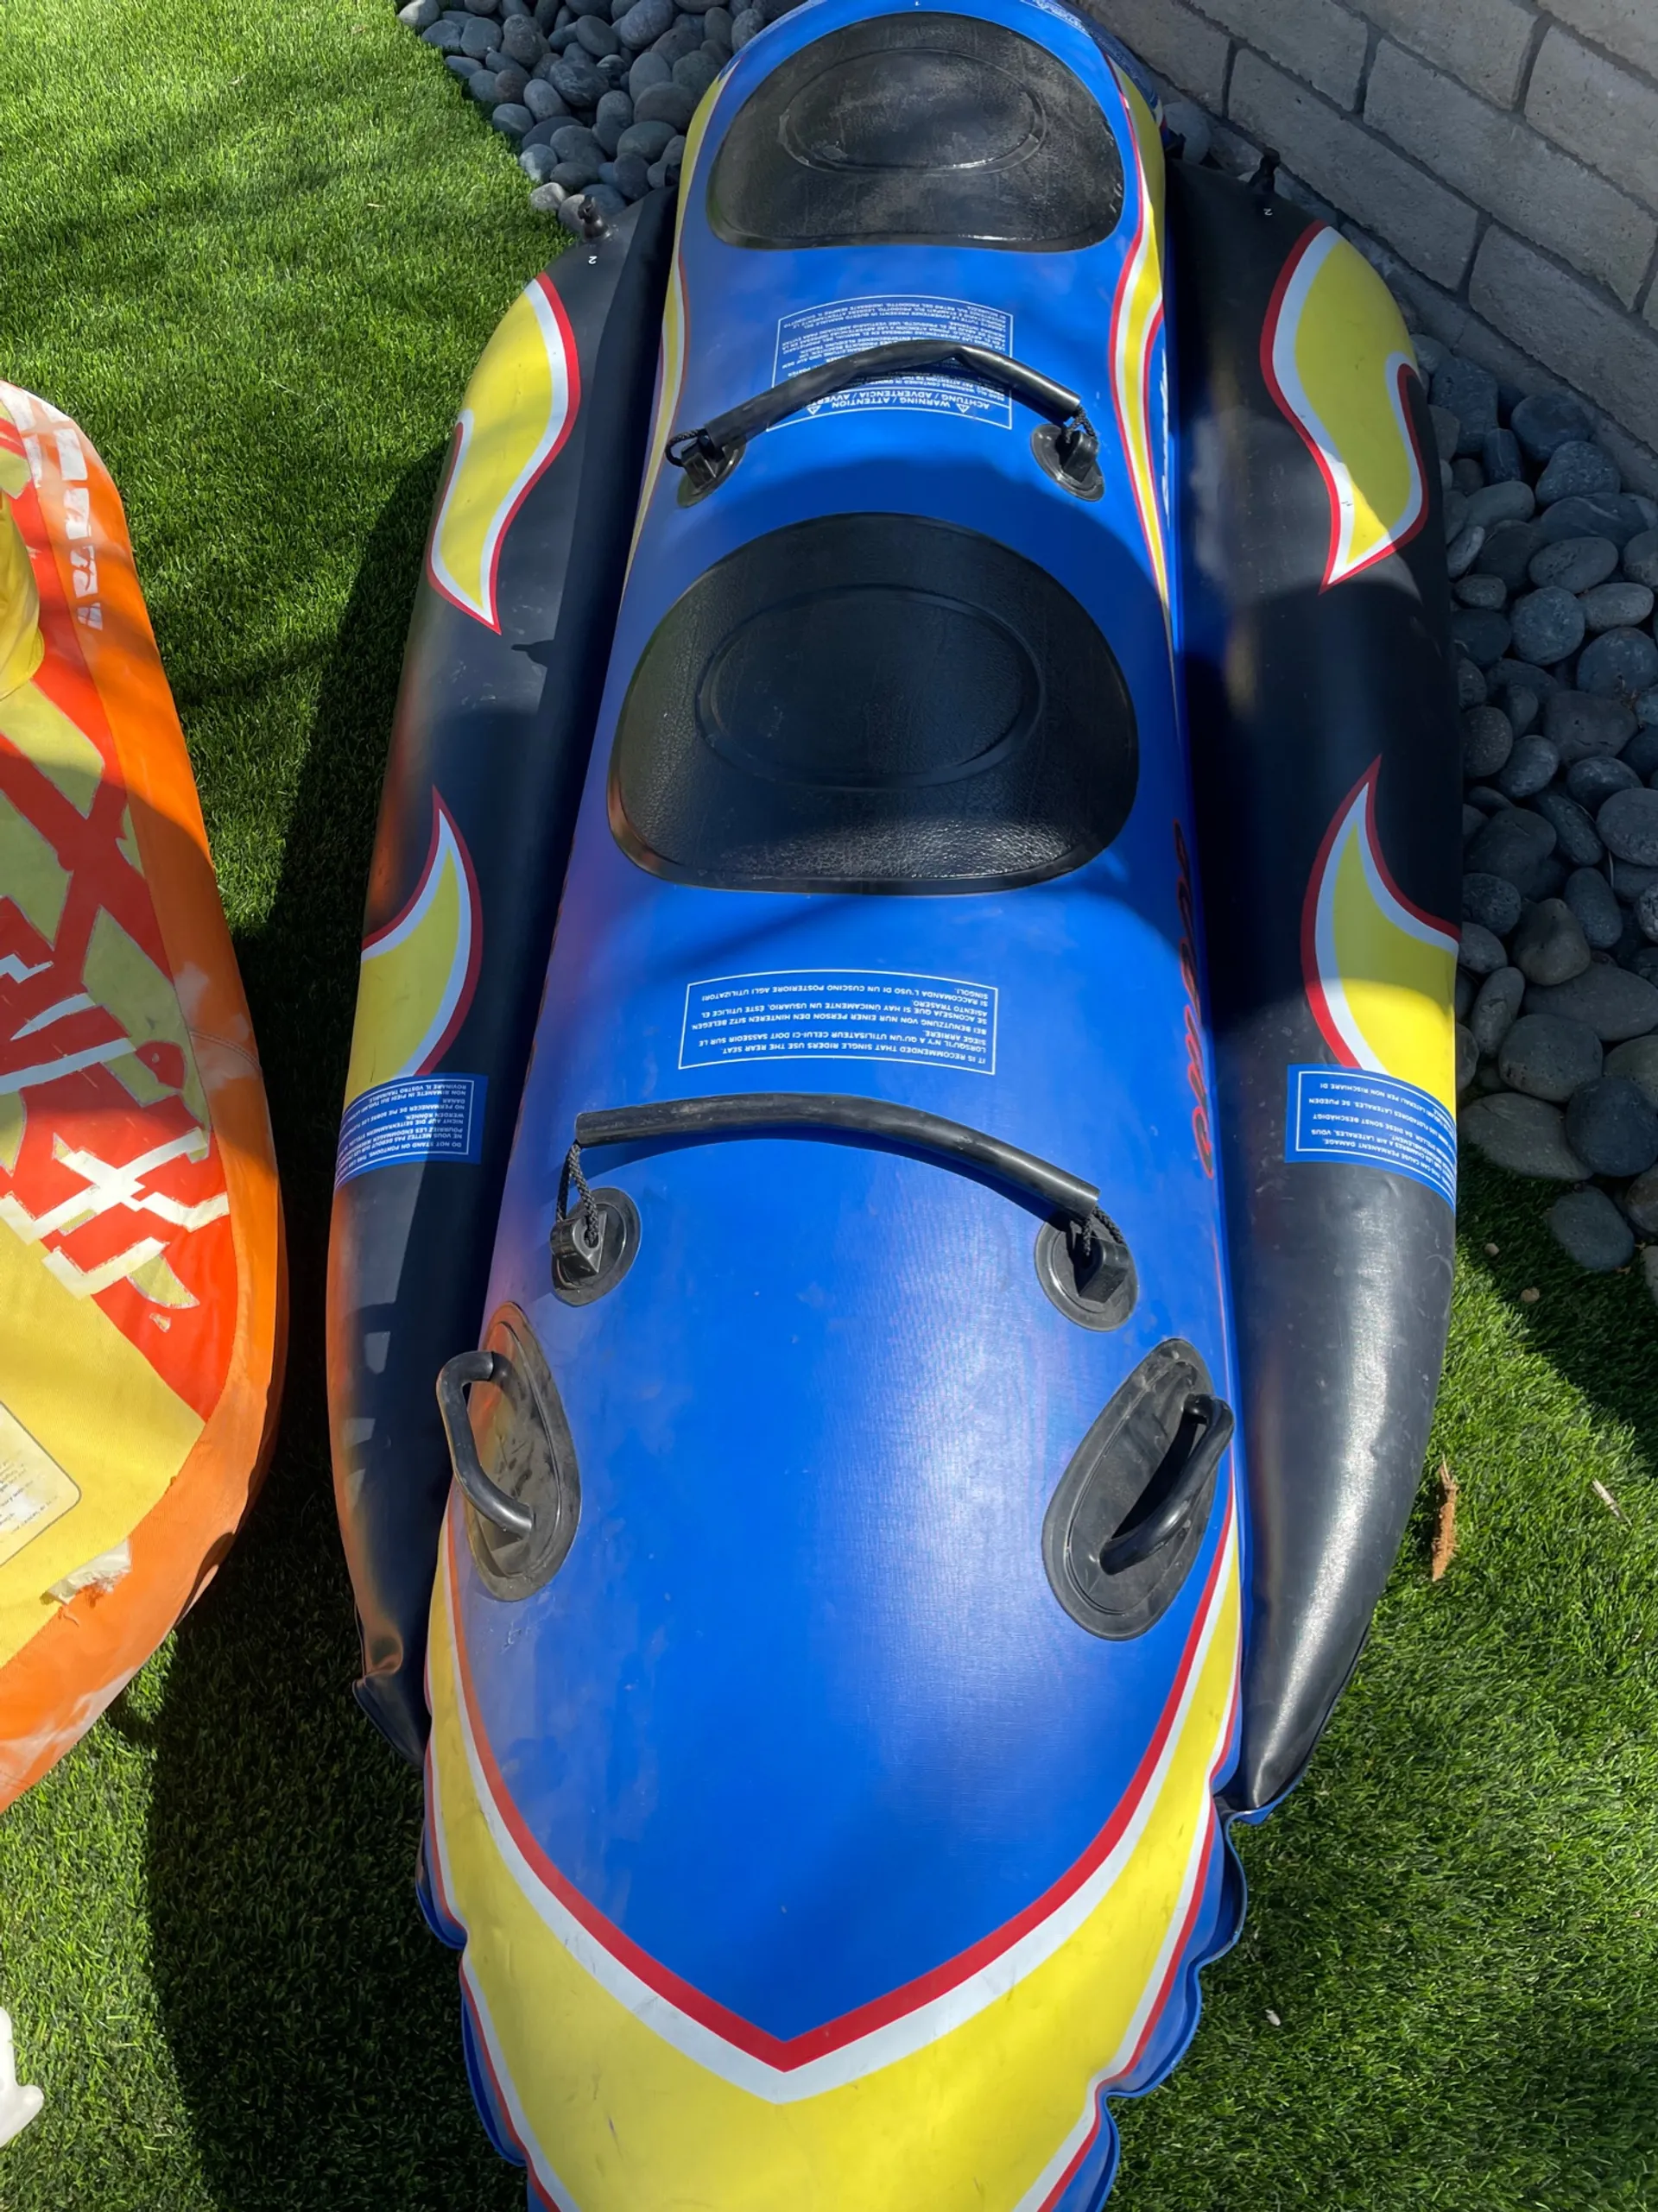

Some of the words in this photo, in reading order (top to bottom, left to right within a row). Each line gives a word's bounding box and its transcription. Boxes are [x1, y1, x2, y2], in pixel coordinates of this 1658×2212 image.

[588, 256, 598, 264] 2
[832, 397, 889, 408] ATTENTION
[900, 397, 951, 408] WARNING
[941, 393, 990, 409] ACHTUNG
[772, 984, 825, 993] POSTERIORE
[921, 990, 978, 1005] RACCOMANDA
[712, 1007, 743, 1017] UTILICE
[933, 1010, 975, 1022] ACONSEJA
[953, 1006, 987, 1017] ASIENTO
[749, 1014, 790, 1022] HINTEREN
[921, 1019, 971, 1032] BENUTZUNG
[832, 1032, 887, 1040] UTILISATEUR
[841, 1042, 872, 1051] SINGLE
[944, 1040, 986, 1053] LORSQU'IL
[900, 1046, 965, 1061] RECOMMENDED
[1331, 1084, 1368, 1094] RISCHIARE
[1370, 1089, 1385, 1097] NON
[1387, 1093, 1398, 1102] PER
[1361, 1119, 1383, 1128] SONST
[1385, 1123, 1404, 1134] DIESE
[1357, 1142, 1400, 1158] PERMANENT
